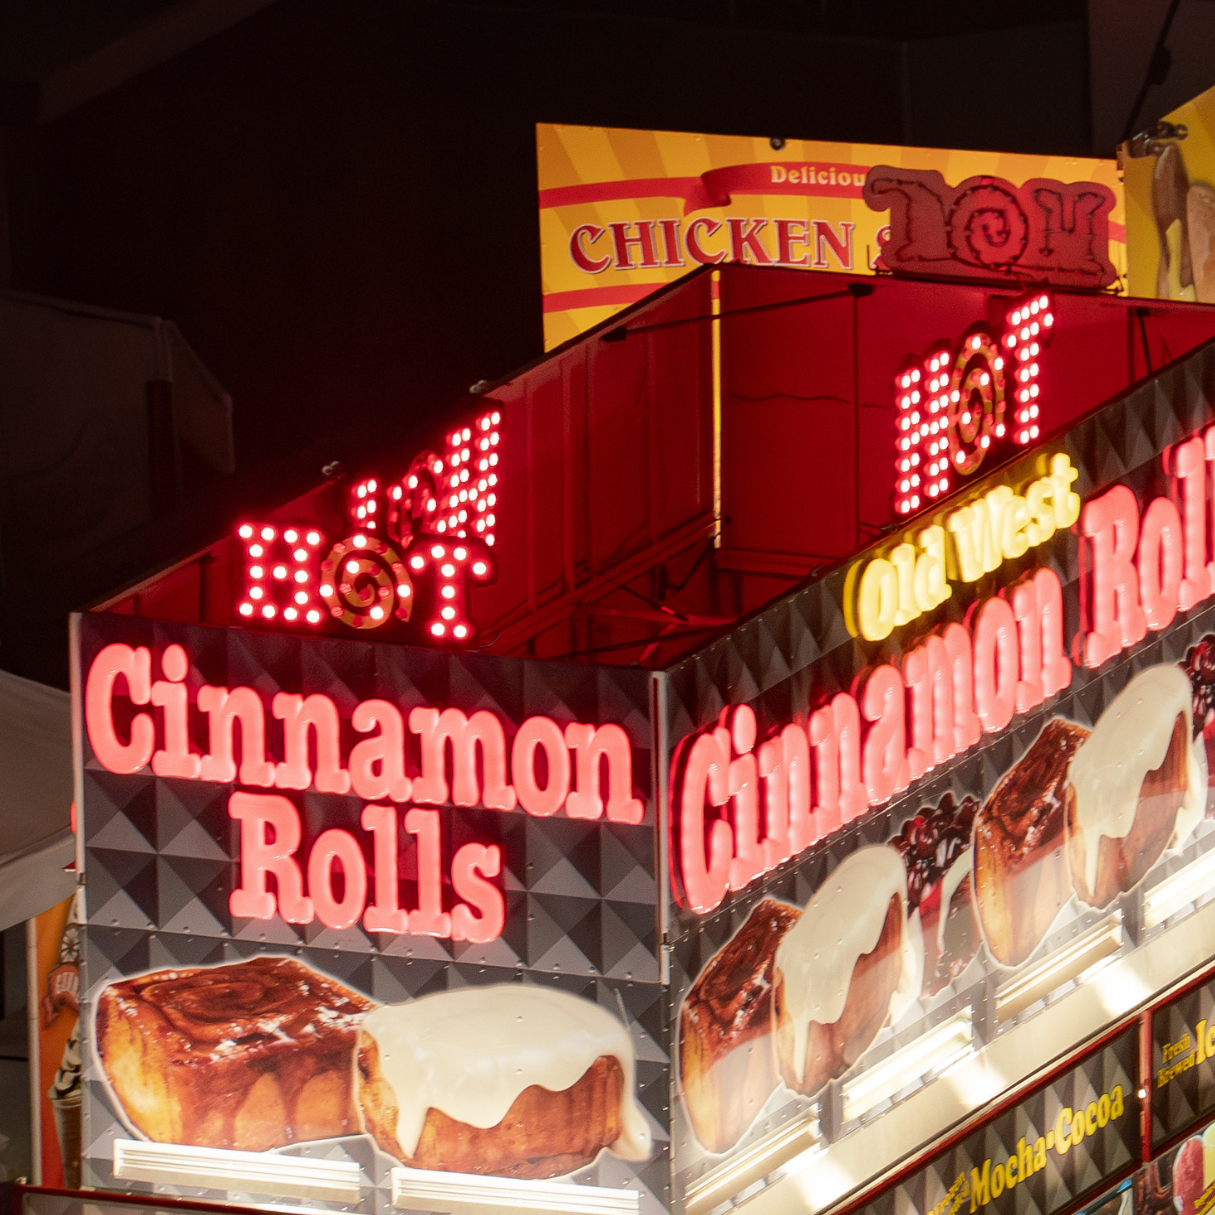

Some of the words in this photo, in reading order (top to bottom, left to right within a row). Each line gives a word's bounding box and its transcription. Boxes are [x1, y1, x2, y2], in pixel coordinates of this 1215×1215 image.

[568, 216, 855, 274] CHICKEN
[770, 165, 866, 189] Deliciou
[894, 291, 1055, 516] HOT
[236, 521, 490, 640] HOT
[845, 524, 953, 642] Old
[948, 453, 1081, 583] West
[84, 642, 645, 825] Cinnamon
[669, 567, 1073, 915] Cinnamon
[228, 791, 506, 944] Rolls
[1162, 1033, 1192, 1064] Fresh
[969, 1136, 1048, 1214] Mocha
[1054, 1084, 1125, 1155] Cocoa
